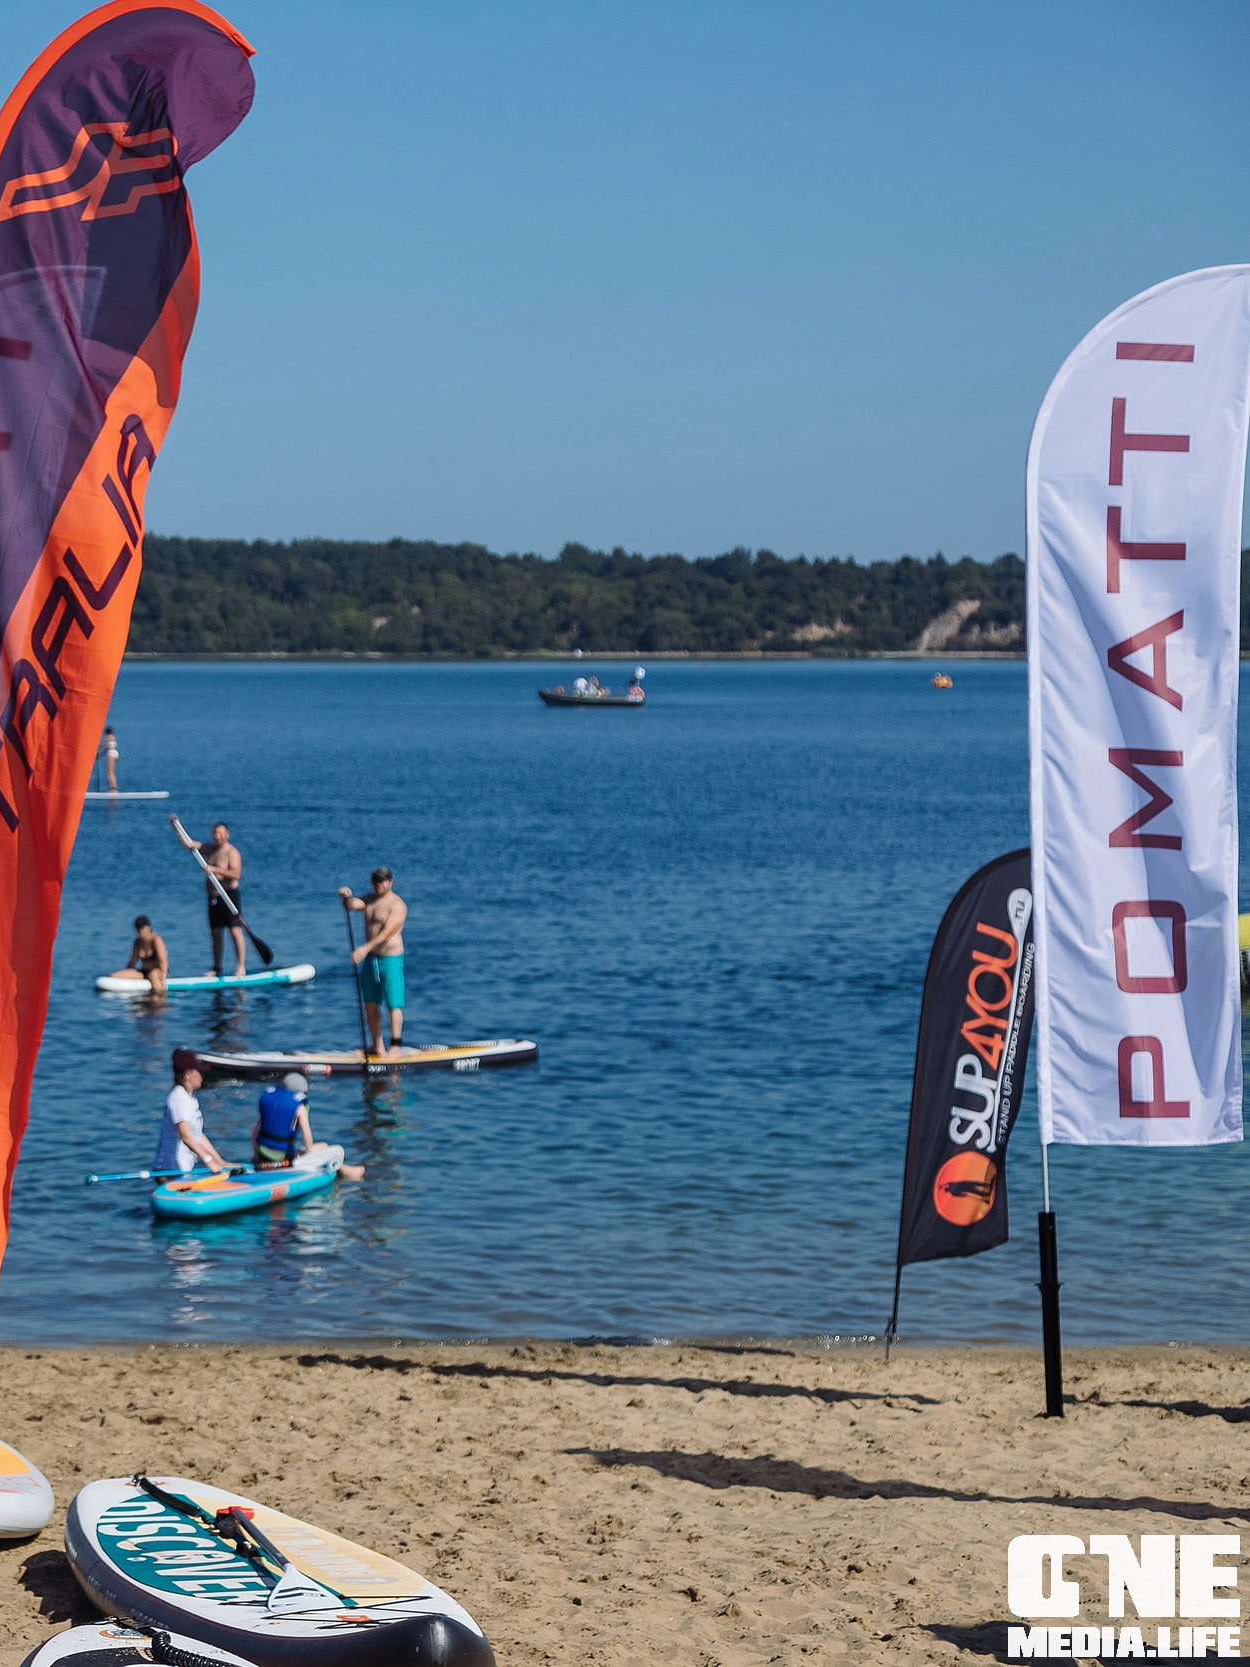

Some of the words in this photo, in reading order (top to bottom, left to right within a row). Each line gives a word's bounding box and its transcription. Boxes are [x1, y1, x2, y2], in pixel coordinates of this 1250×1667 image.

[1106, 341, 1195, 1119] POMATTI
[949, 921, 1020, 1148] SUP4YOU
[1004, 1017, 1022, 1075] PADDLE
[1001, 1075, 1013, 1096] UP
[997, 1098, 1012, 1144] STAND
